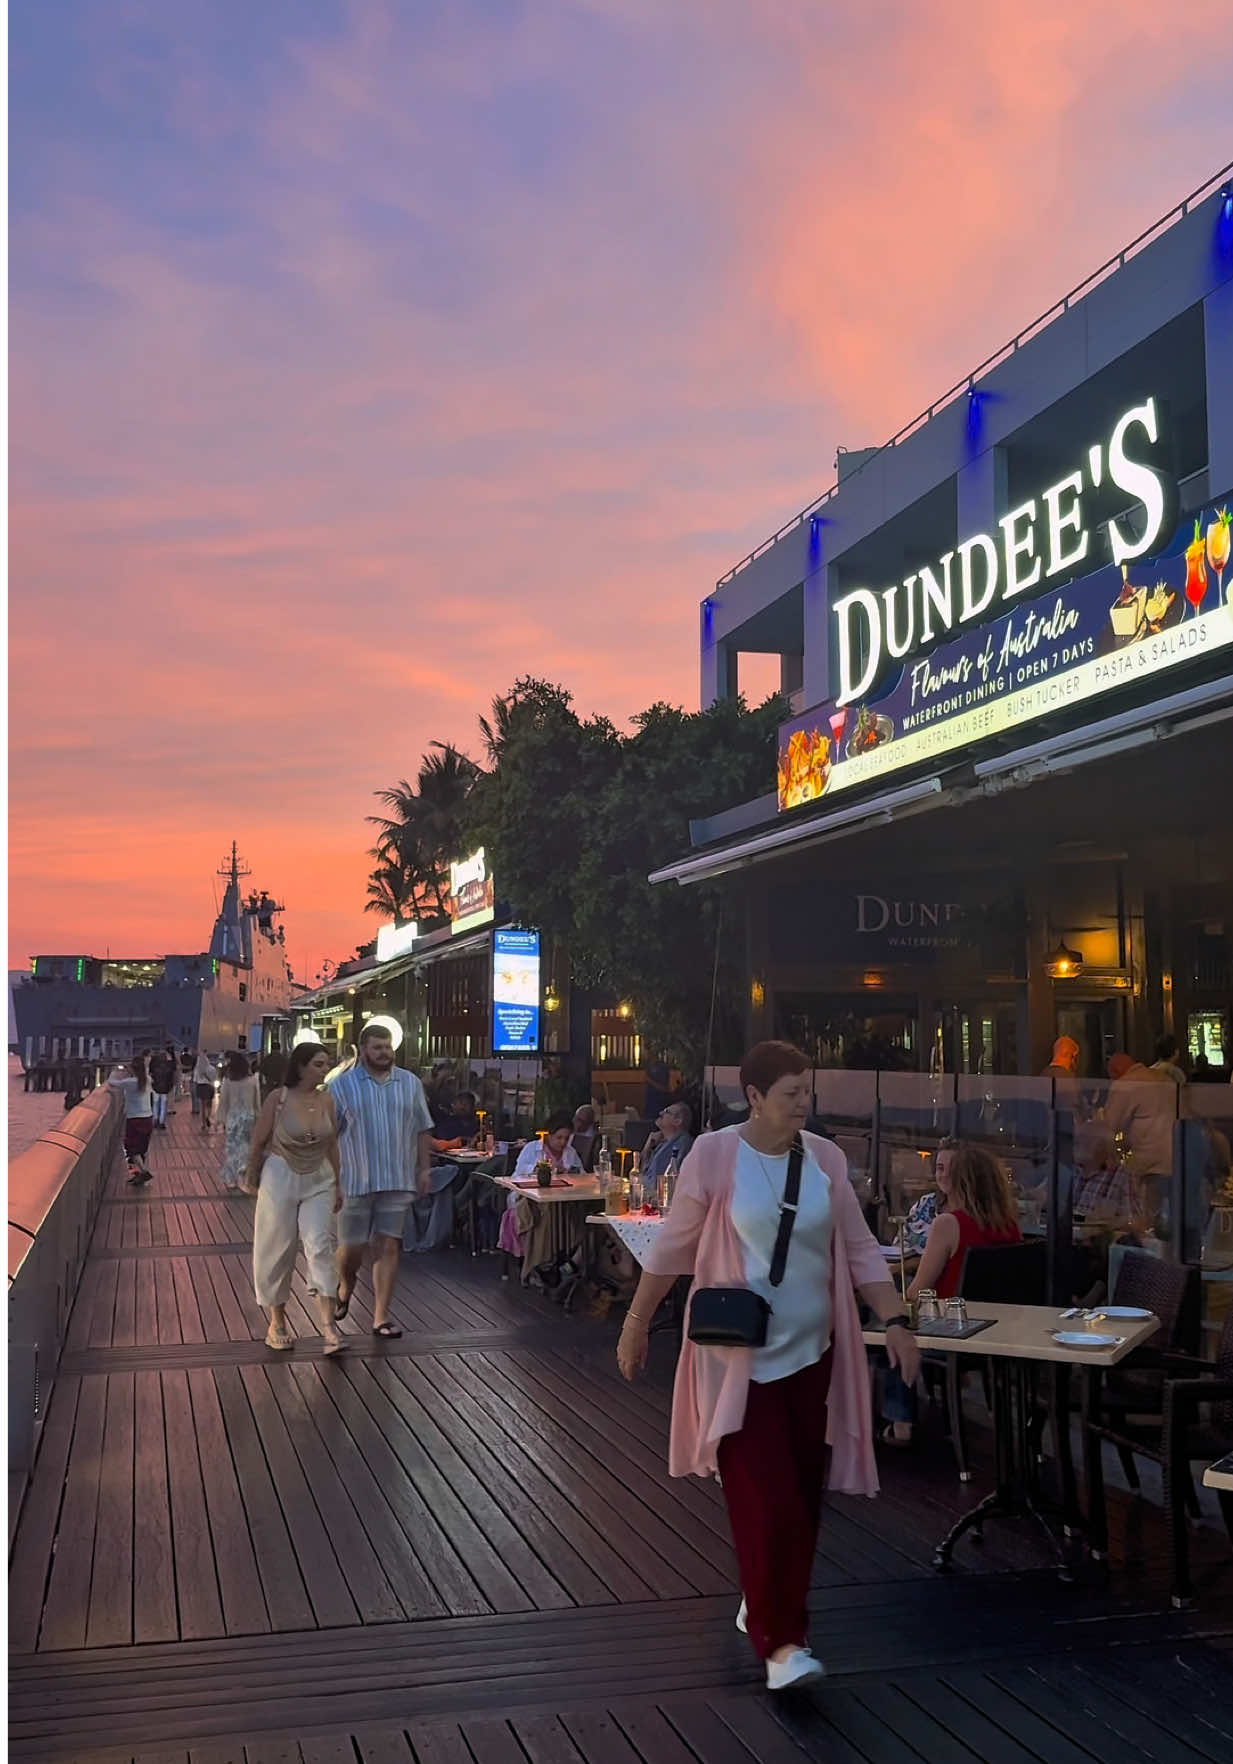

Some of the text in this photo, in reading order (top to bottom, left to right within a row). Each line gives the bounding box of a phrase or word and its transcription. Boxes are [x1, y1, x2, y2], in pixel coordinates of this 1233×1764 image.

[832, 397, 1163, 707] DUNDEE'S
[902, 694, 963, 731] WATERFRONT
[965, 675, 1005, 706] DINING
[1016, 657, 1048, 683] OPEN
[1052, 651, 1059, 669] 7
[1061, 636, 1094, 665] DAYS
[910, 598, 1080, 707] Flavours of Australia
[972, 708, 996, 732] BEEF
[1007, 692, 1032, 718] BUSH
[1036, 675, 1080, 706] TUCKER
[1095, 656, 1133, 684] PASTA
[1137, 649, 1147, 667] &
[1151, 623, 1208, 661] SALADS
